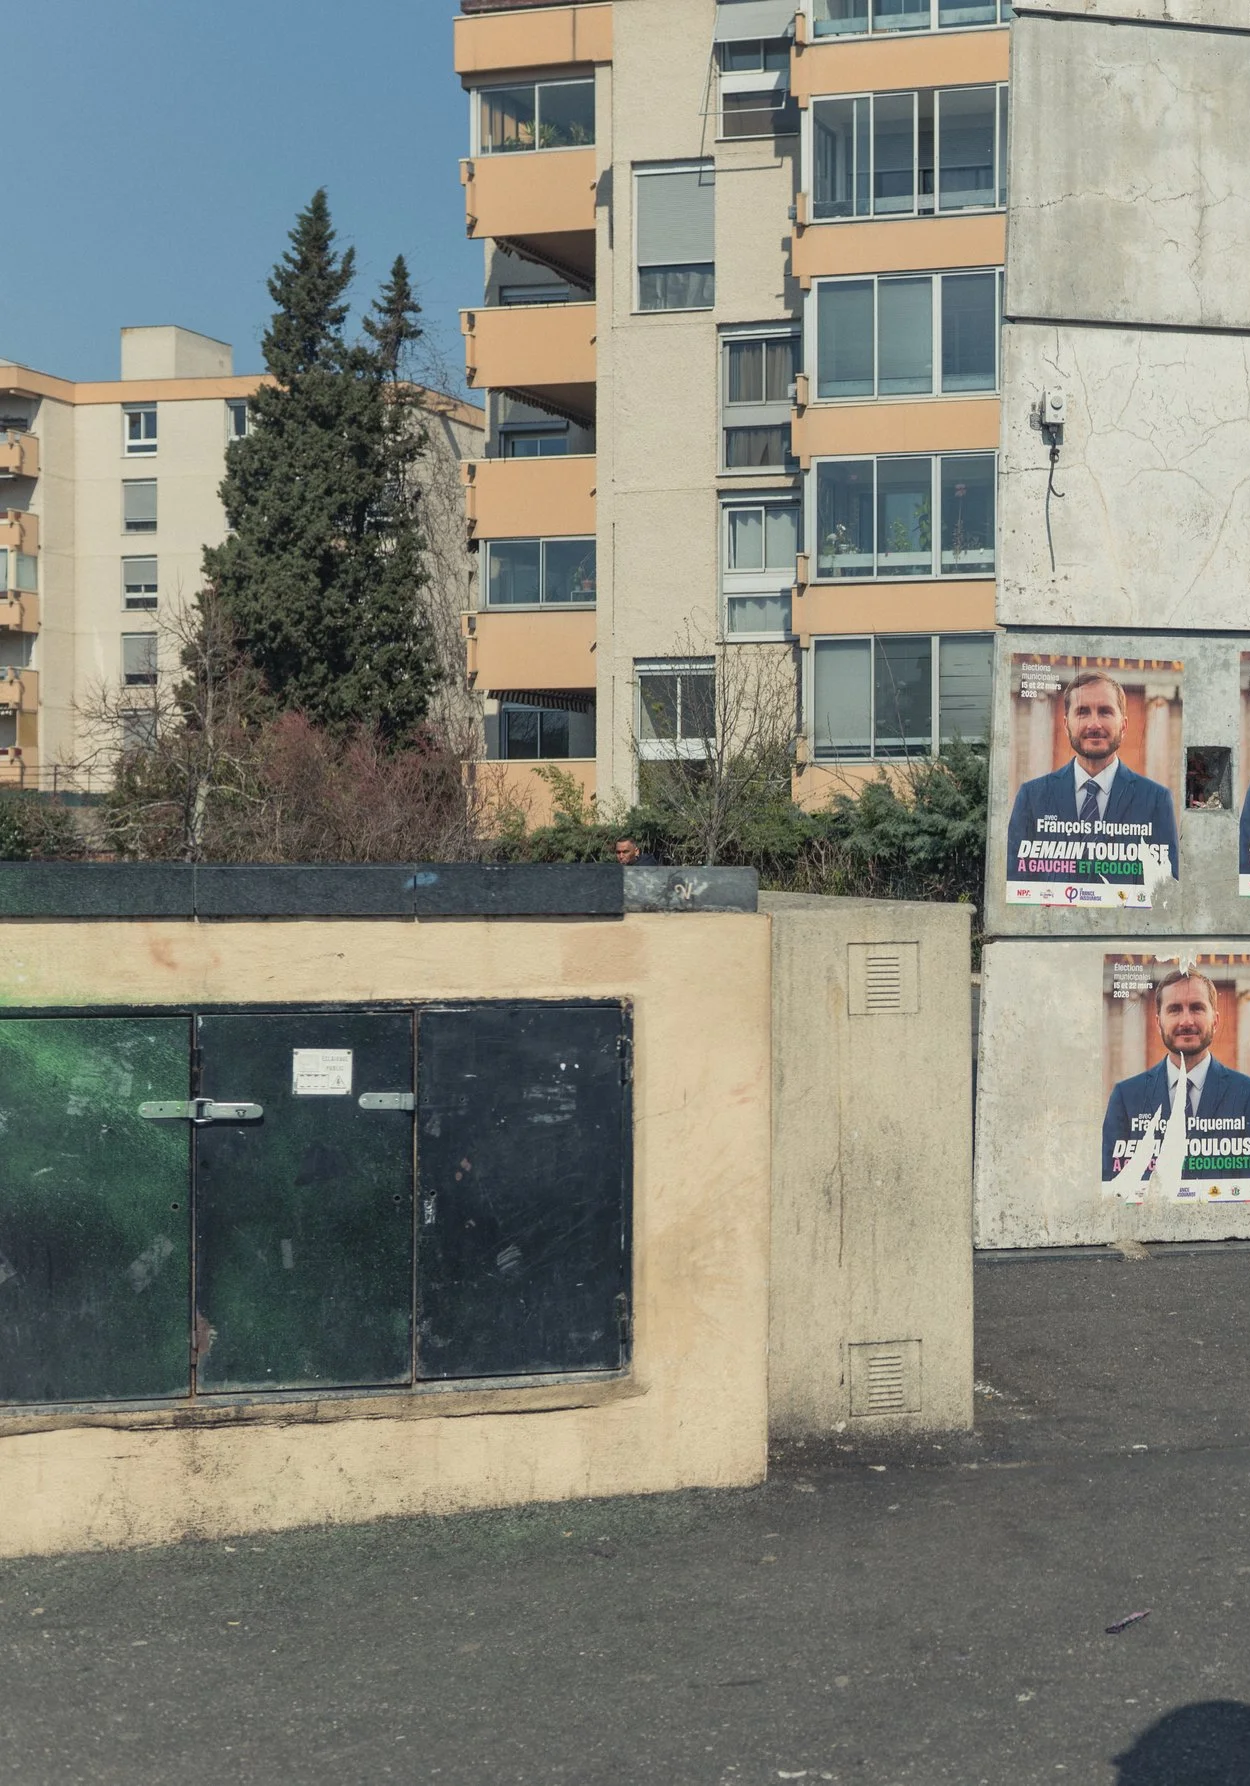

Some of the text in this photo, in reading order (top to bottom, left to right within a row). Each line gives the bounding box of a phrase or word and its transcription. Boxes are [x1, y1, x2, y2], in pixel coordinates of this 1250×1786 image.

[1021, 661, 1051, 671] Élections
[1021, 673, 1060, 681] municipales
[1021, 681, 1028, 689] 15
[1020, 690, 1037, 698] 2026
[1036, 818, 1153, 837] François Piquemal
[1017, 840, 1087, 860] DEMAIN
[1017, 857, 1142, 875] À GAUCHE ET ÉCOLOGI
[1114, 962, 1144, 971] Élections
[1113, 973, 1151, 981] municipales
[1113, 981, 1120, 989] 15
[1113, 990, 1130, 998] 2026
[1187, 1116, 1246, 1132] Piquemal
[1113, 1156, 1121, 1172] À
